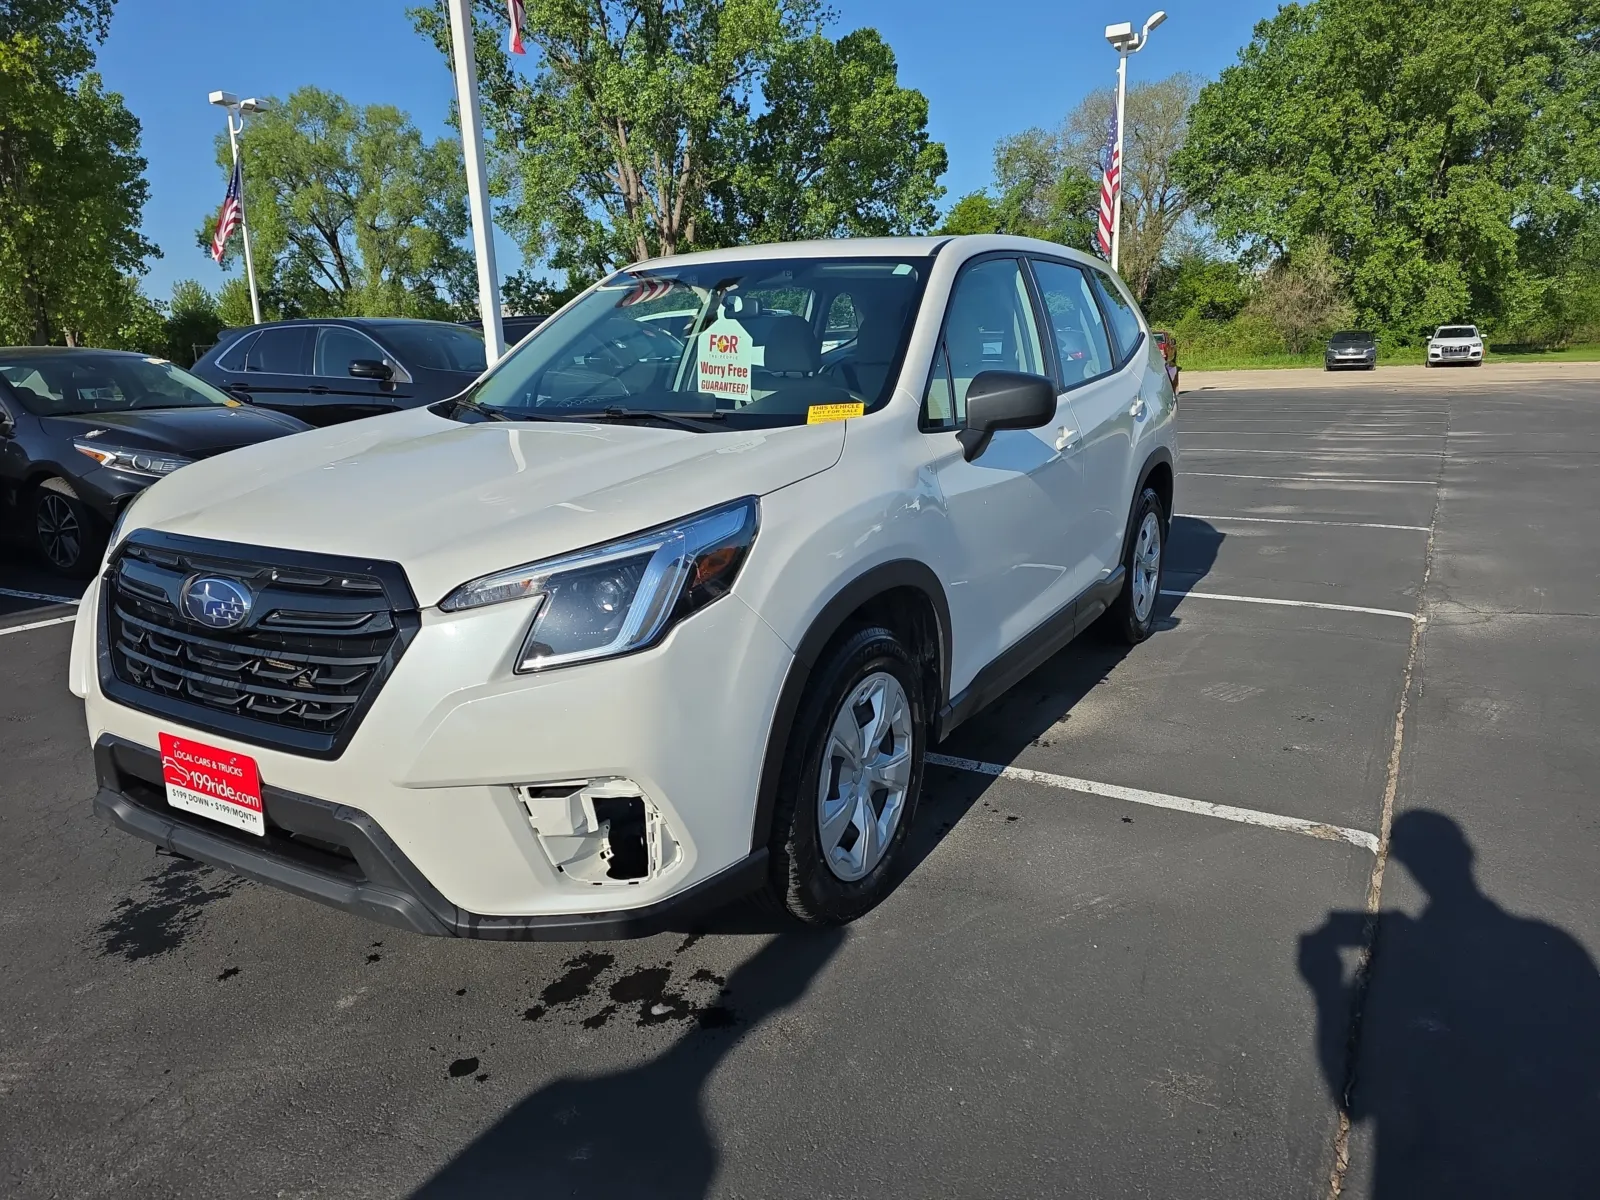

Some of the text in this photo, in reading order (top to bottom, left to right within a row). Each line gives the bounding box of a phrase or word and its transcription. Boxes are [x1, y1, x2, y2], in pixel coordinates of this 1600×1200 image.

[709, 334, 739, 354] FOR
[700, 361, 748, 379] Worry Free
[701, 380, 749, 394] GUARANTEED!
[174, 750, 243, 777] LOCAL CARS & TRUCKS
[190, 770, 259, 808] 199ride.com
[172, 788, 257, 823] $199 DOWN $199/MONTH
